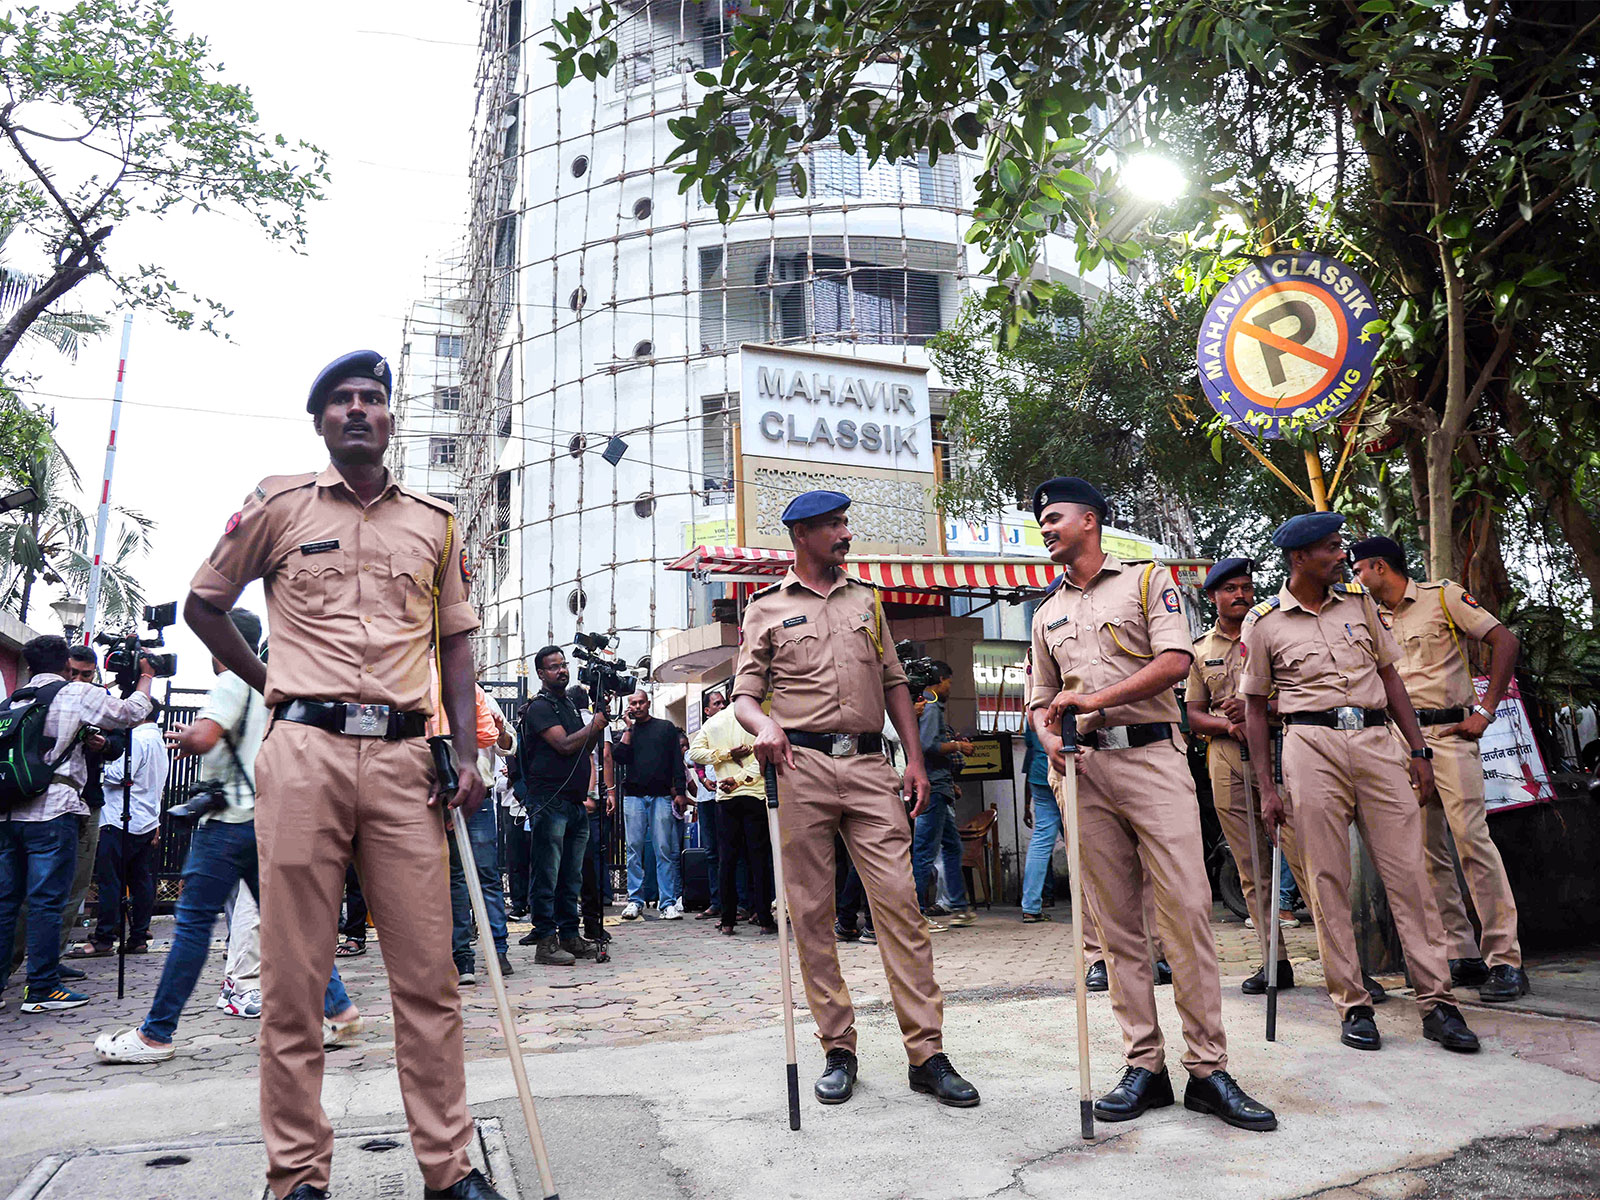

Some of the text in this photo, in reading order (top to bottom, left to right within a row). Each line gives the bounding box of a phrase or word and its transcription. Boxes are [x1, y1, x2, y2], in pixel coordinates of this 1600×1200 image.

[1202, 258, 1372, 381] MAHAVIR CLASSIK
[758, 365, 916, 414] MAHAVIR
[759, 410, 919, 456] CLASSIK
